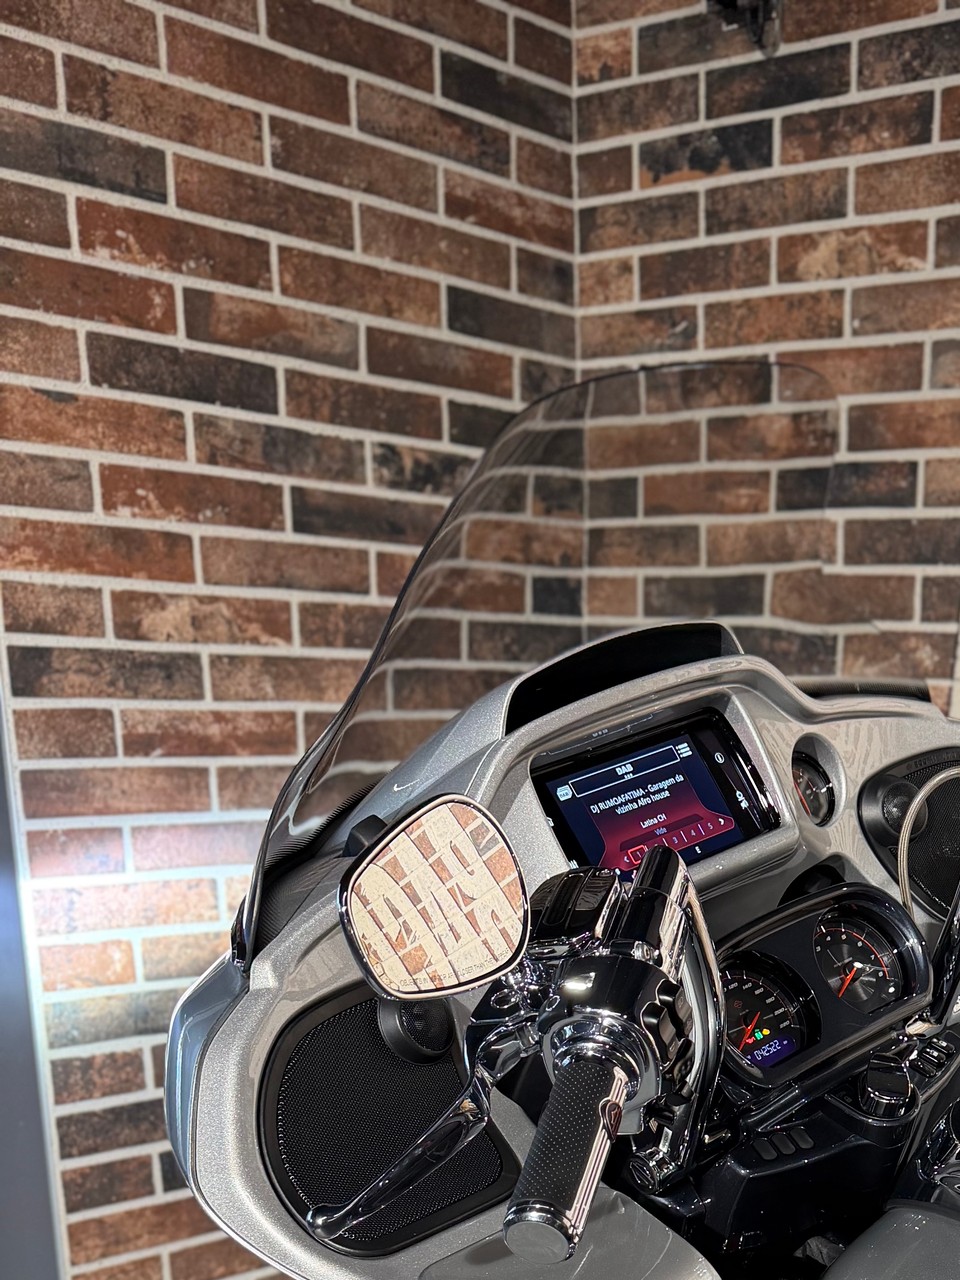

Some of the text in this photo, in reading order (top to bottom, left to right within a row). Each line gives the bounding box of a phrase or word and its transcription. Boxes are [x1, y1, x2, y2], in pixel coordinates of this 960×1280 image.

[615, 763, 634, 775] DAB
[647, 777, 675, 792] Garagem
[674, 774, 684, 782] da
[615, 790, 670, 815] vizinha Afro house
[640, 813, 667, 828] Latina CH
